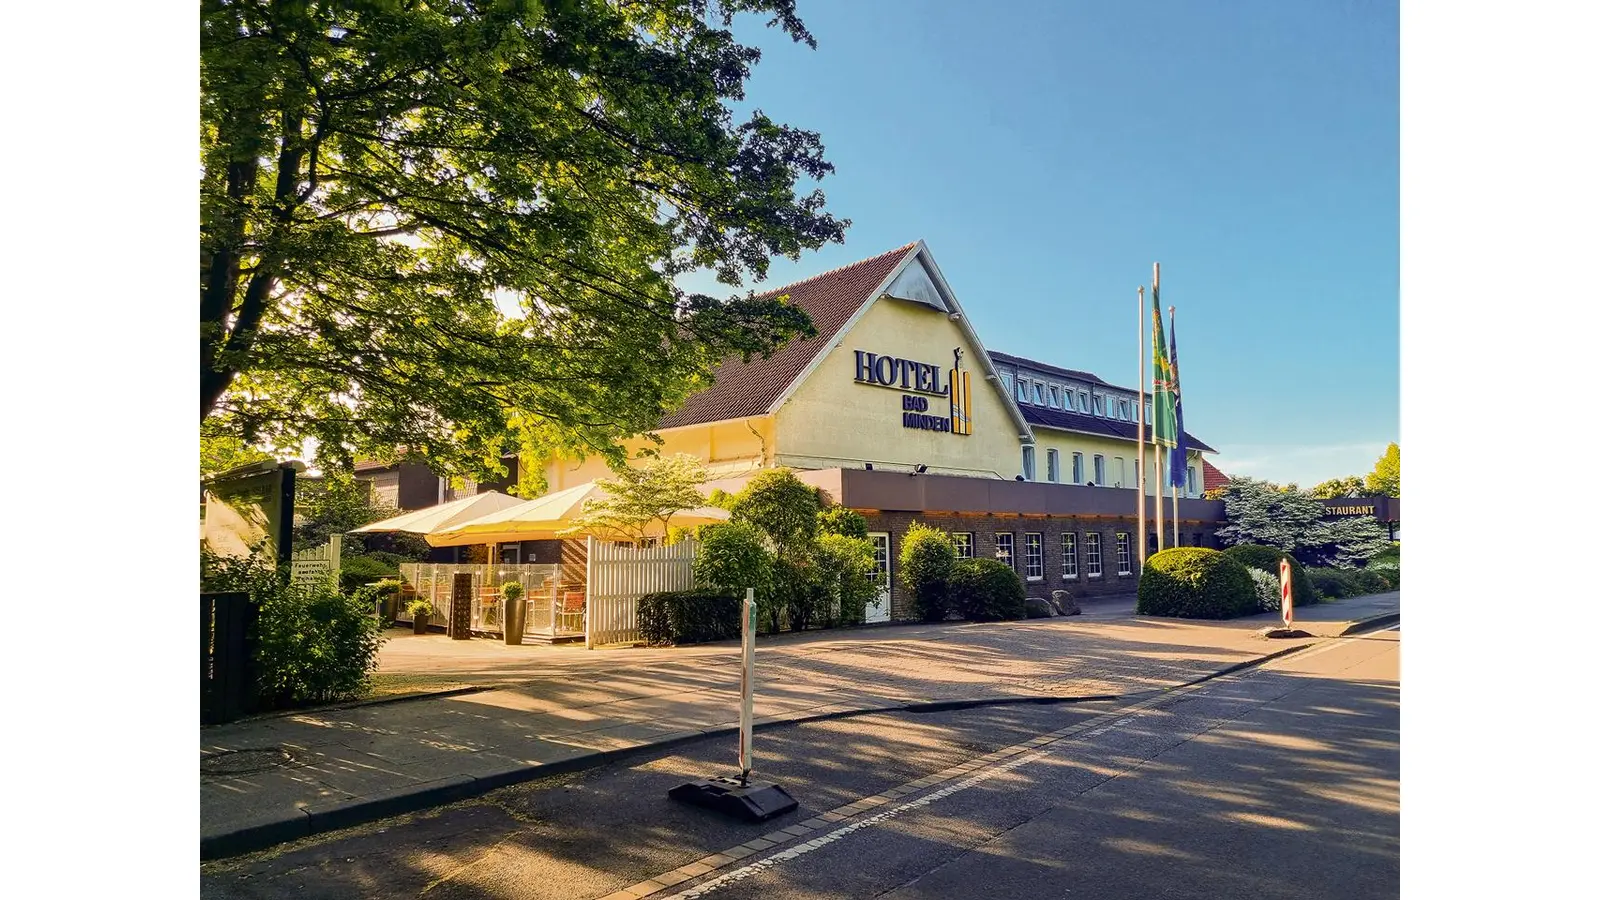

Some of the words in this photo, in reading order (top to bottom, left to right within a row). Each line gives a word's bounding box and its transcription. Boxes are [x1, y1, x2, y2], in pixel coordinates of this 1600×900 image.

[854, 350, 949, 396] HOTEL
[903, 395, 929, 412] BAD
[903, 412, 950, 433] MINDEN
[1325, 505, 1375, 516] STAURANT
